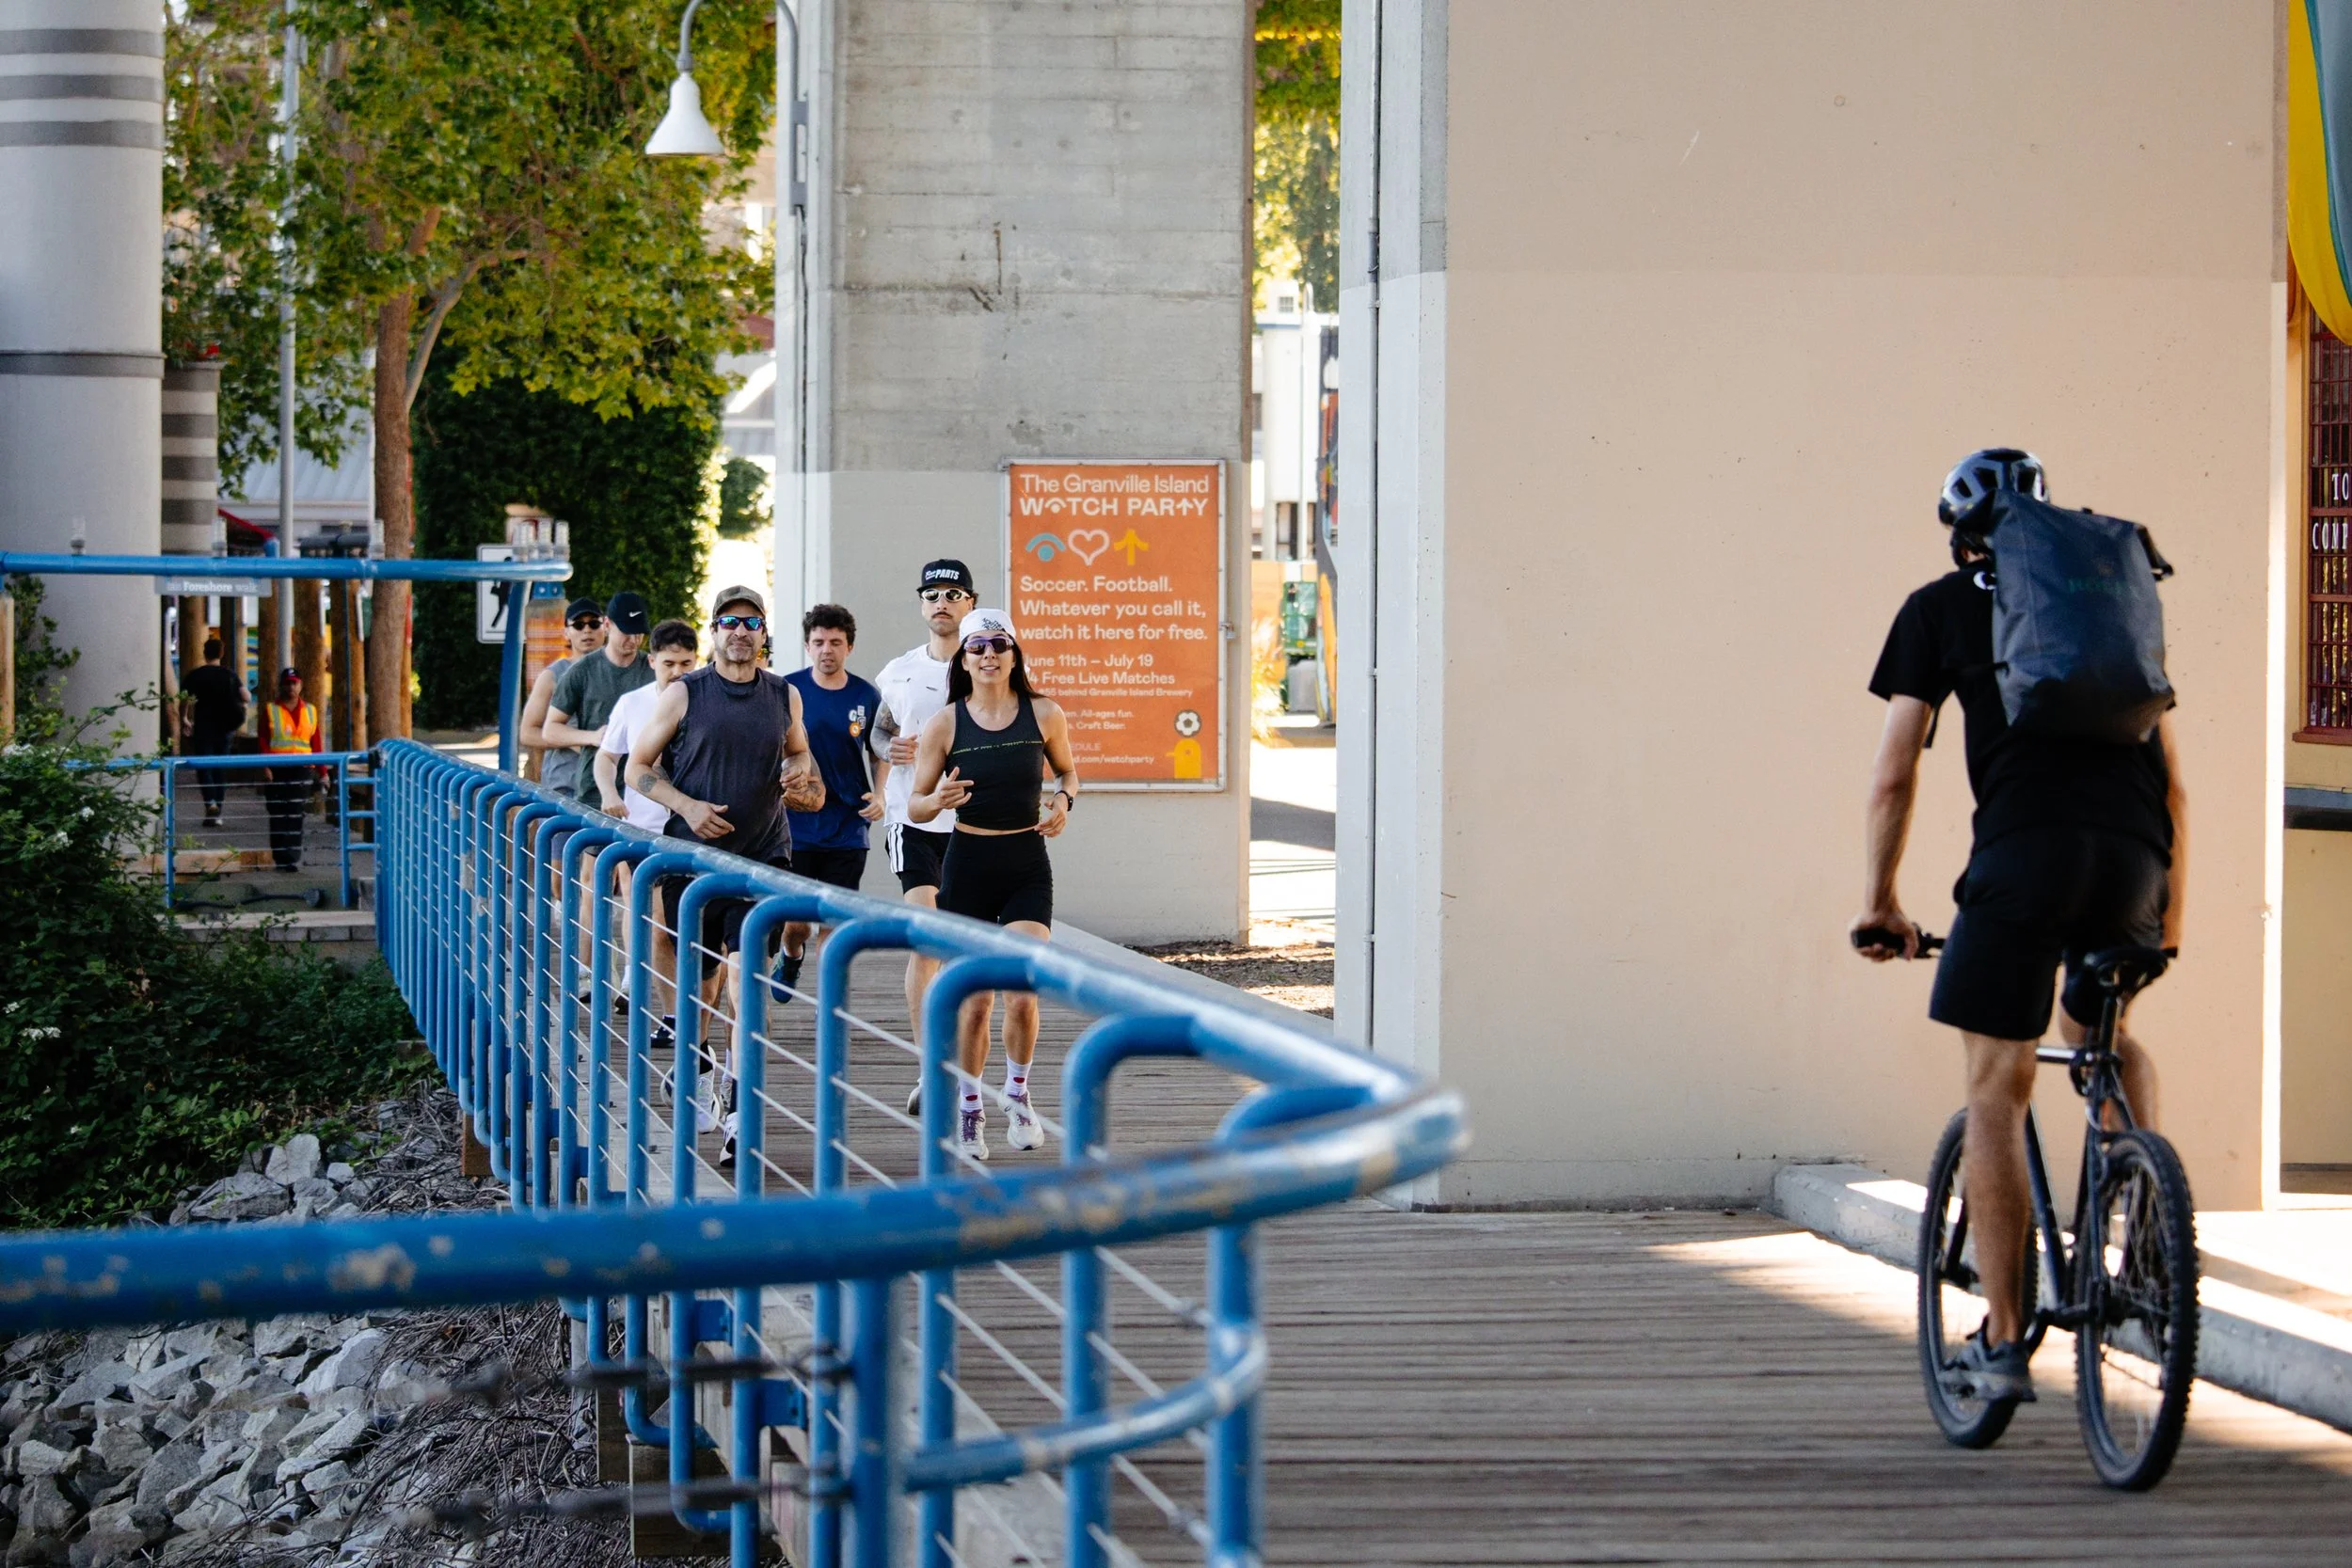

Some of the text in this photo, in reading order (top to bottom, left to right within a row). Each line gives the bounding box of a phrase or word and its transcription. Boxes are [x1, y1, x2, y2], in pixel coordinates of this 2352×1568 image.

[1020, 473, 1209, 493] The Granville Island
[935, 569, 960, 579] PARTS
[183, 580, 233, 593] Foreshore
[1020, 575, 1172, 593] Soccer. Football.
[1020, 600, 1206, 620] Whatever you call it,
[1020, 625, 1208, 641] watch it here for free.
[1059, 654, 1087, 667] 11th
[1104, 655, 1134, 669] July
[1137, 654, 1153, 667] 19
[1042, 672, 1075, 685] Free
[1078, 672, 1109, 685] Live
[1113, 672, 1175, 685] Matches
[1058, 688, 1088, 696] behind
[1089, 688, 1127, 696] Granville
[1129, 688, 1154, 696] Island
[1156, 688, 1193, 698] Brewery
